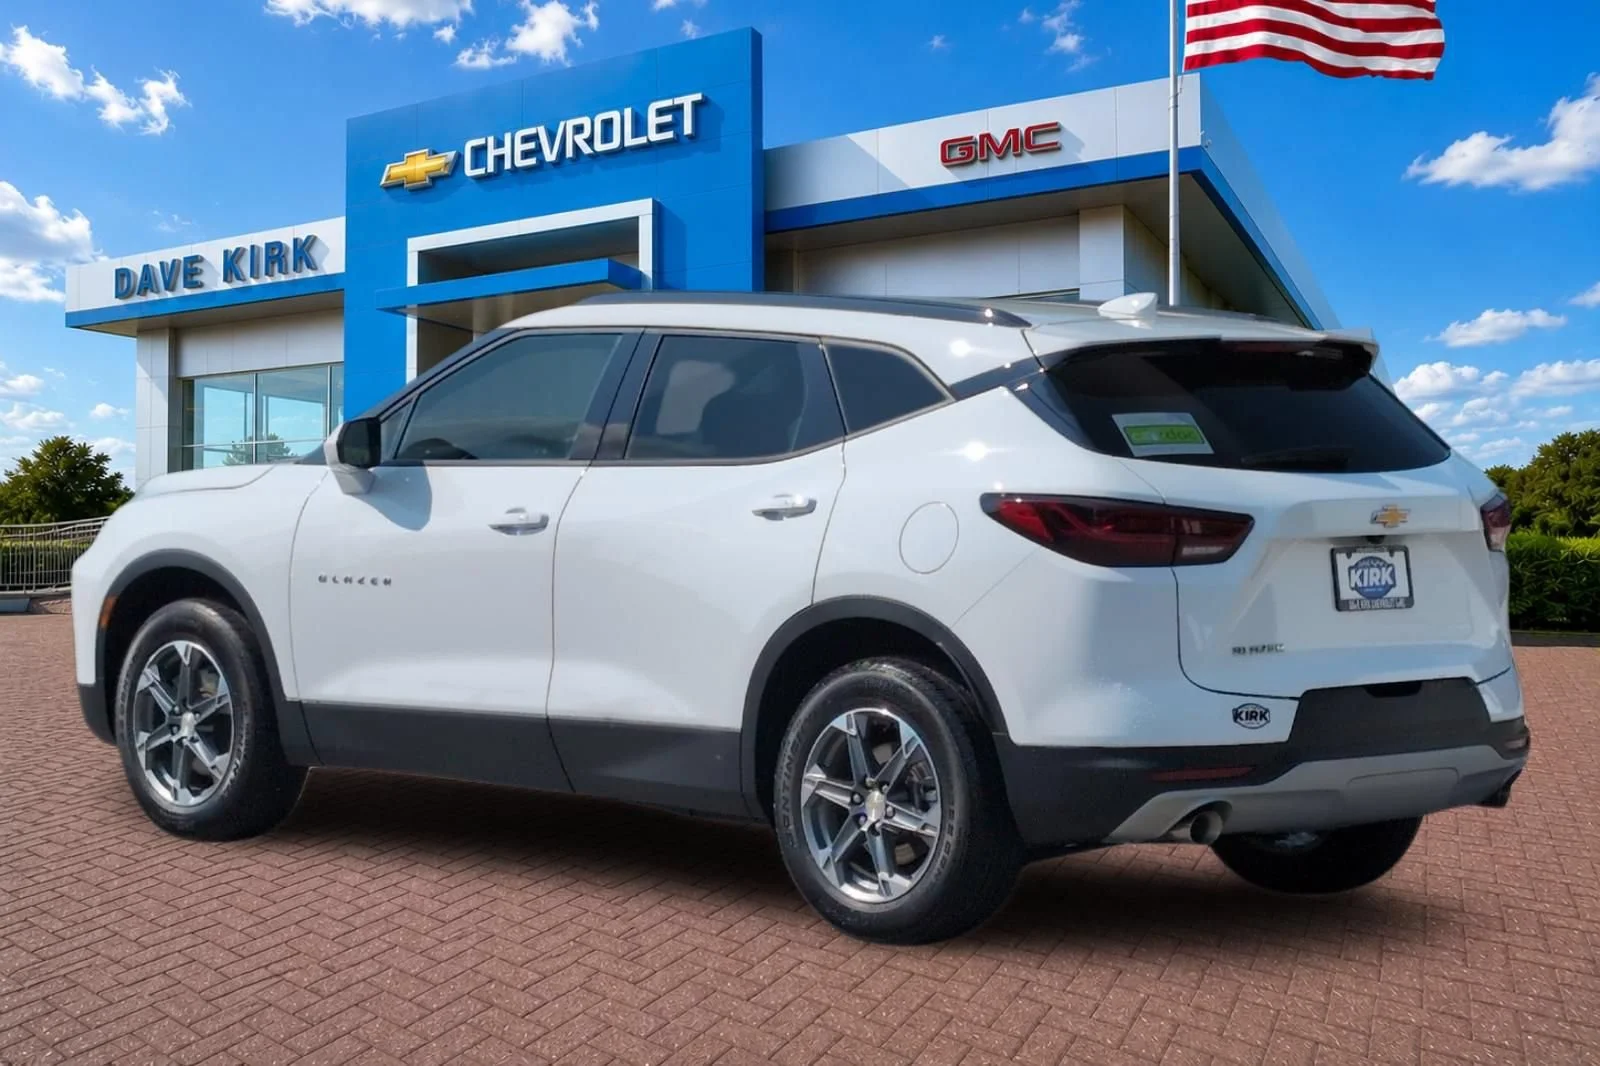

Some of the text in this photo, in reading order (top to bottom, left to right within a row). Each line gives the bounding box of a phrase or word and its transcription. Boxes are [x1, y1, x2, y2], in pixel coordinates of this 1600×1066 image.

[463, 92, 705, 178] CHEVROLET
[940, 121, 1061, 166] GMC
[114, 234, 318, 299] DAVE KIRK
[1350, 566, 1394, 588] KIRK
[1233, 709, 1268, 721] KIRK
